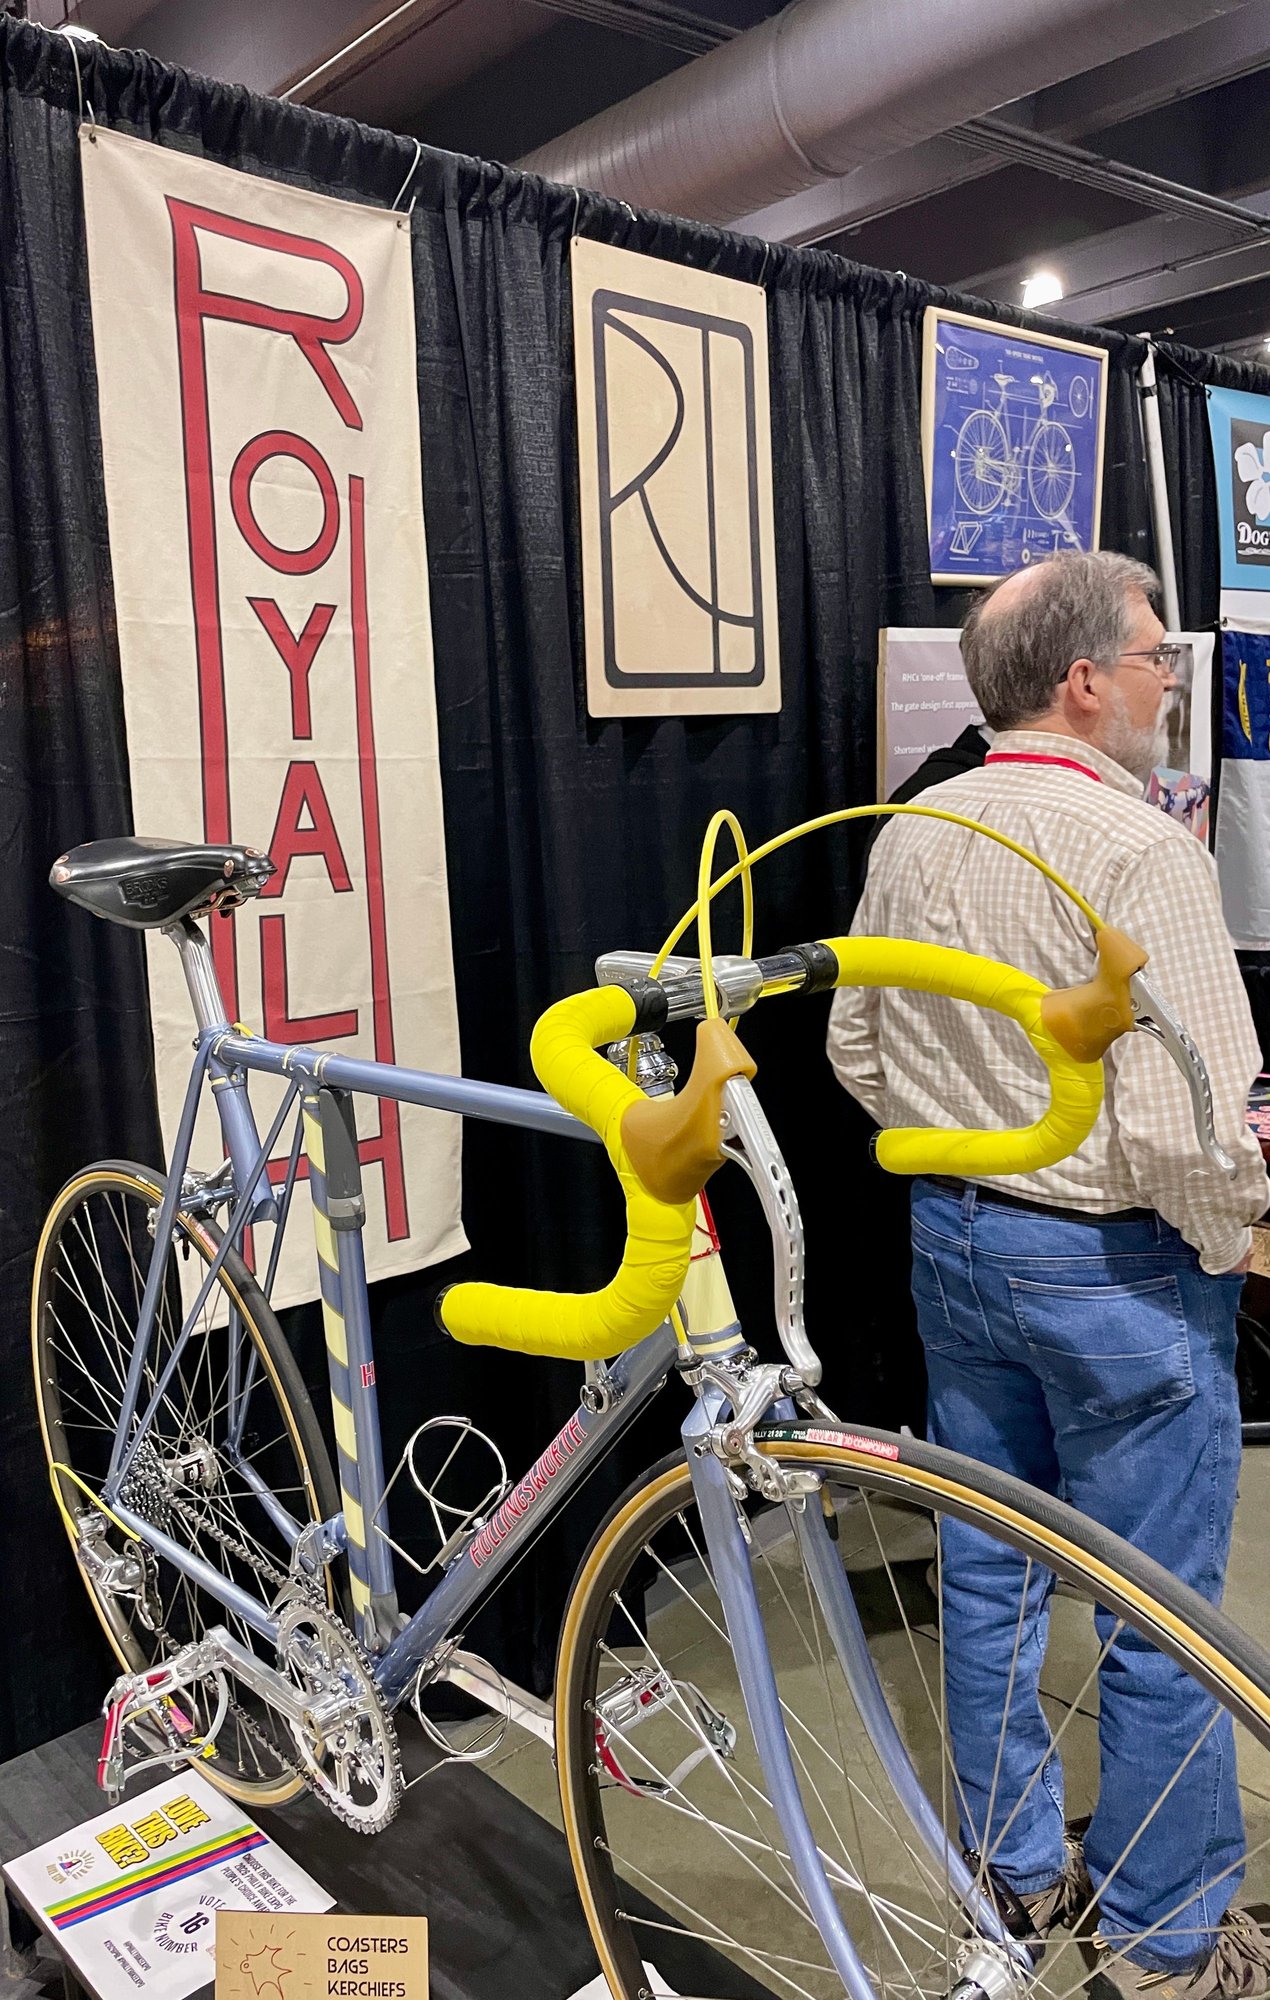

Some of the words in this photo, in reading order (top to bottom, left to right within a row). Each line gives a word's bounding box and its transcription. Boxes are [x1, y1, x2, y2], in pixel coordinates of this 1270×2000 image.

[1237, 521, 1270, 546] DOG
[891, 701, 904, 712] The
[904, 702, 920, 713] gate
[920, 700, 941, 712] design
[942, 699, 955, 709] first
[893, 744, 926, 756] Shortened
[125, 876, 169, 895] BROOKS
[752, 1430, 767, 1439] ALLY
[807, 1430, 839, 1443] KEVLAR
[854, 1437, 894, 1457] COMPOUND
[469, 1411, 588, 1569] HOLLINGSWORTH
[160, 1793, 212, 1834] LOVE
[131, 1810, 178, 1849] THIS
[95, 1823, 150, 1870] BIKE?
[220, 1866, 244, 1887] PEOPLE'S
[237, 1883, 258, 1902] CHOICE
[242, 1853, 263, 1871] CHOOSE
[257, 1868, 272, 1880] THIS
[266, 1877, 282, 1890] BIKE
[275, 1886, 289, 1898] FOR
[283, 1894, 298, 1906] THE
[244, 1872, 264, 1890] PHILLY
[257, 1886, 273, 1899] BIKE
[266, 1895, 284, 1910] EXPO
[199, 1894, 226, 1911] VOTE
[153, 1912, 174, 1933] BIKE
[179, 1911, 210, 1935] 16
[155, 1933, 198, 1954] NUMBER
[327, 1936, 409, 1954] COASTERS
[327, 1958, 369, 1974] BAGS
[327, 1980, 406, 1997] KERCHIEFS
